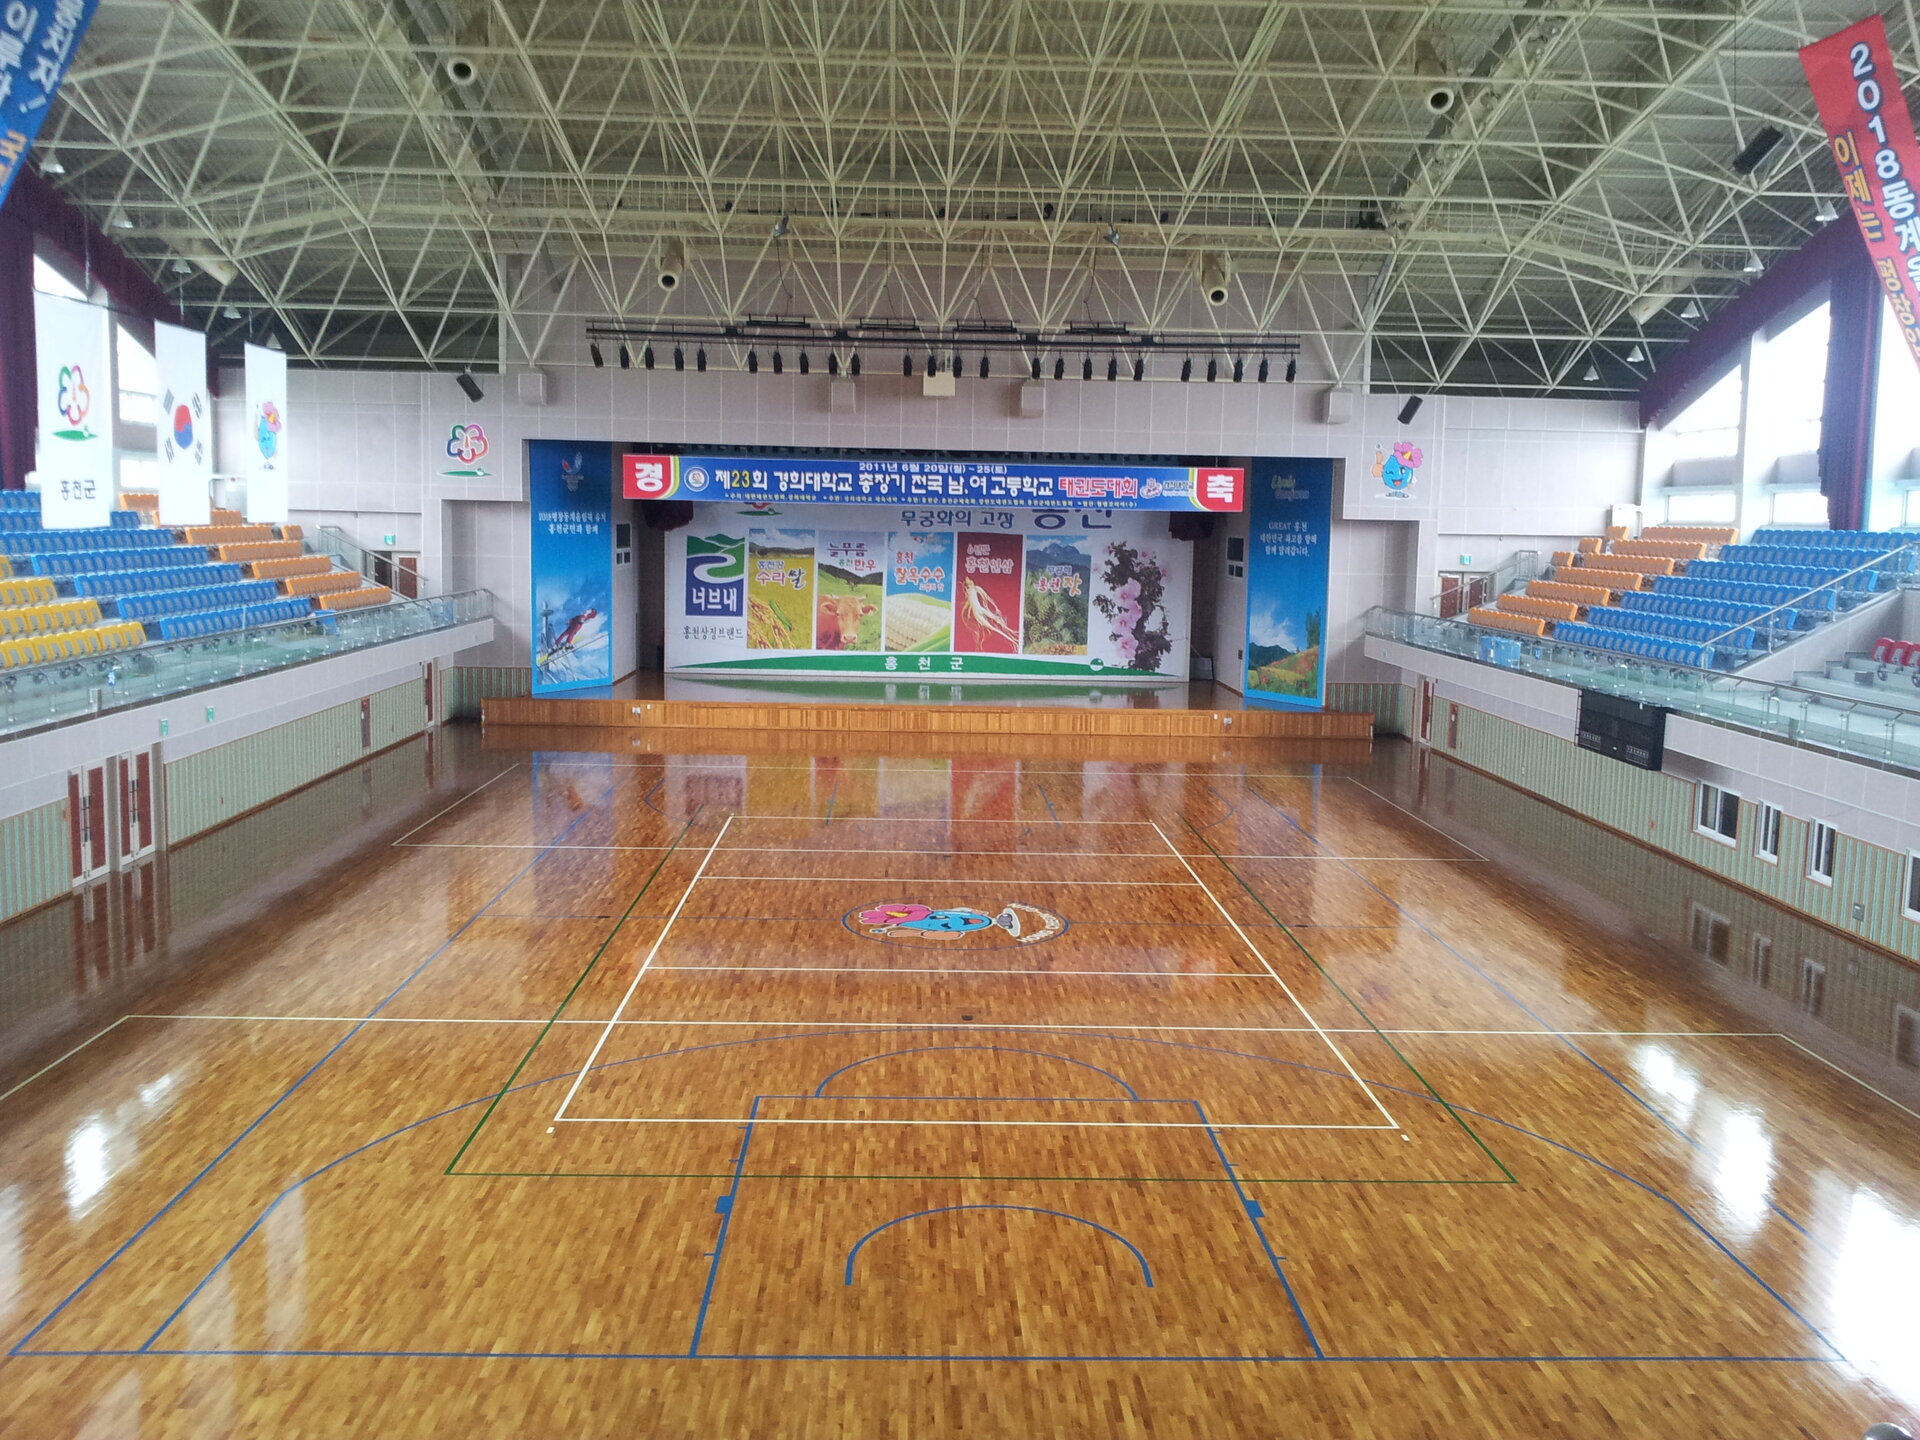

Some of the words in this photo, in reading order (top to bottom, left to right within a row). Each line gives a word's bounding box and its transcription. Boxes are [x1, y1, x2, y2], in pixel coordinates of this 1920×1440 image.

[859, 462, 898, 472] 2011년
[902, 463, 920, 473] 6월
[634, 463, 662, 492] 경
[715, 469, 768, 491] 제23회
[773, 470, 853, 493] 경희대학교
[858, 471, 905, 494] 총장기
[911, 473, 943, 495] 전국
[991, 476, 1054, 497] 고등학교
[1058, 476, 1138, 499] 태권도대회
[60, 479, 97, 500] 홍천군
[1206, 474, 1234, 503] 축
[901, 510, 971, 528] 무궁화의
[979, 510, 1015, 528] 고장
[1268, 521, 1291, 530] GREAT
[854, 559, 876, 571] 한우
[895, 551, 914, 564] 홍천
[965, 556, 1015, 574] 홍천인삼
[895, 567, 945, 585] 찰옥수수
[1037, 576, 1061, 594] 홍천
[692, 587, 738, 612] 너브내
